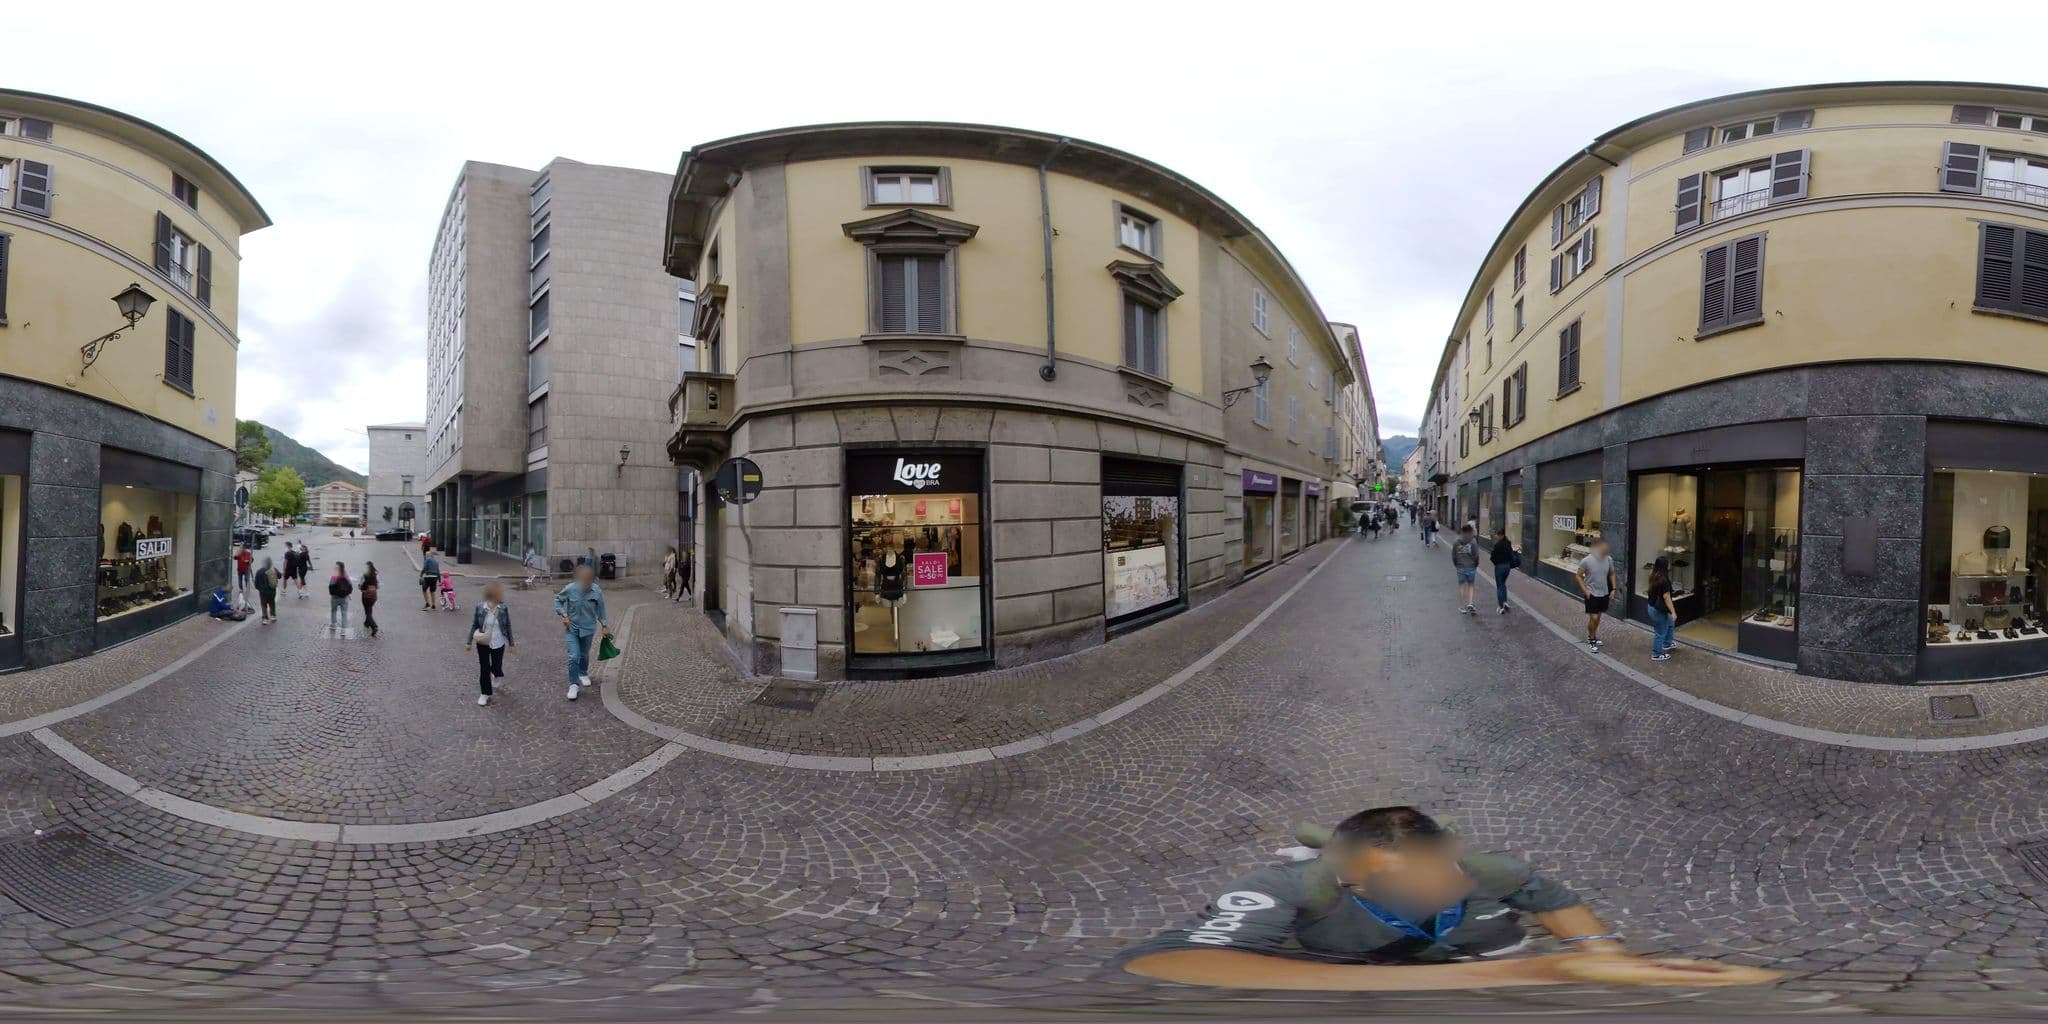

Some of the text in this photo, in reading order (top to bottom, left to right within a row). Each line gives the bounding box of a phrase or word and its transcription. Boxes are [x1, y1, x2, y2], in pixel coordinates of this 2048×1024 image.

[894, 457, 942, 486] Love
[1553, 517, 1575, 530] SALDI
[139, 540, 170, 556] SALDI
[917, 564, 943, 574] SALE
